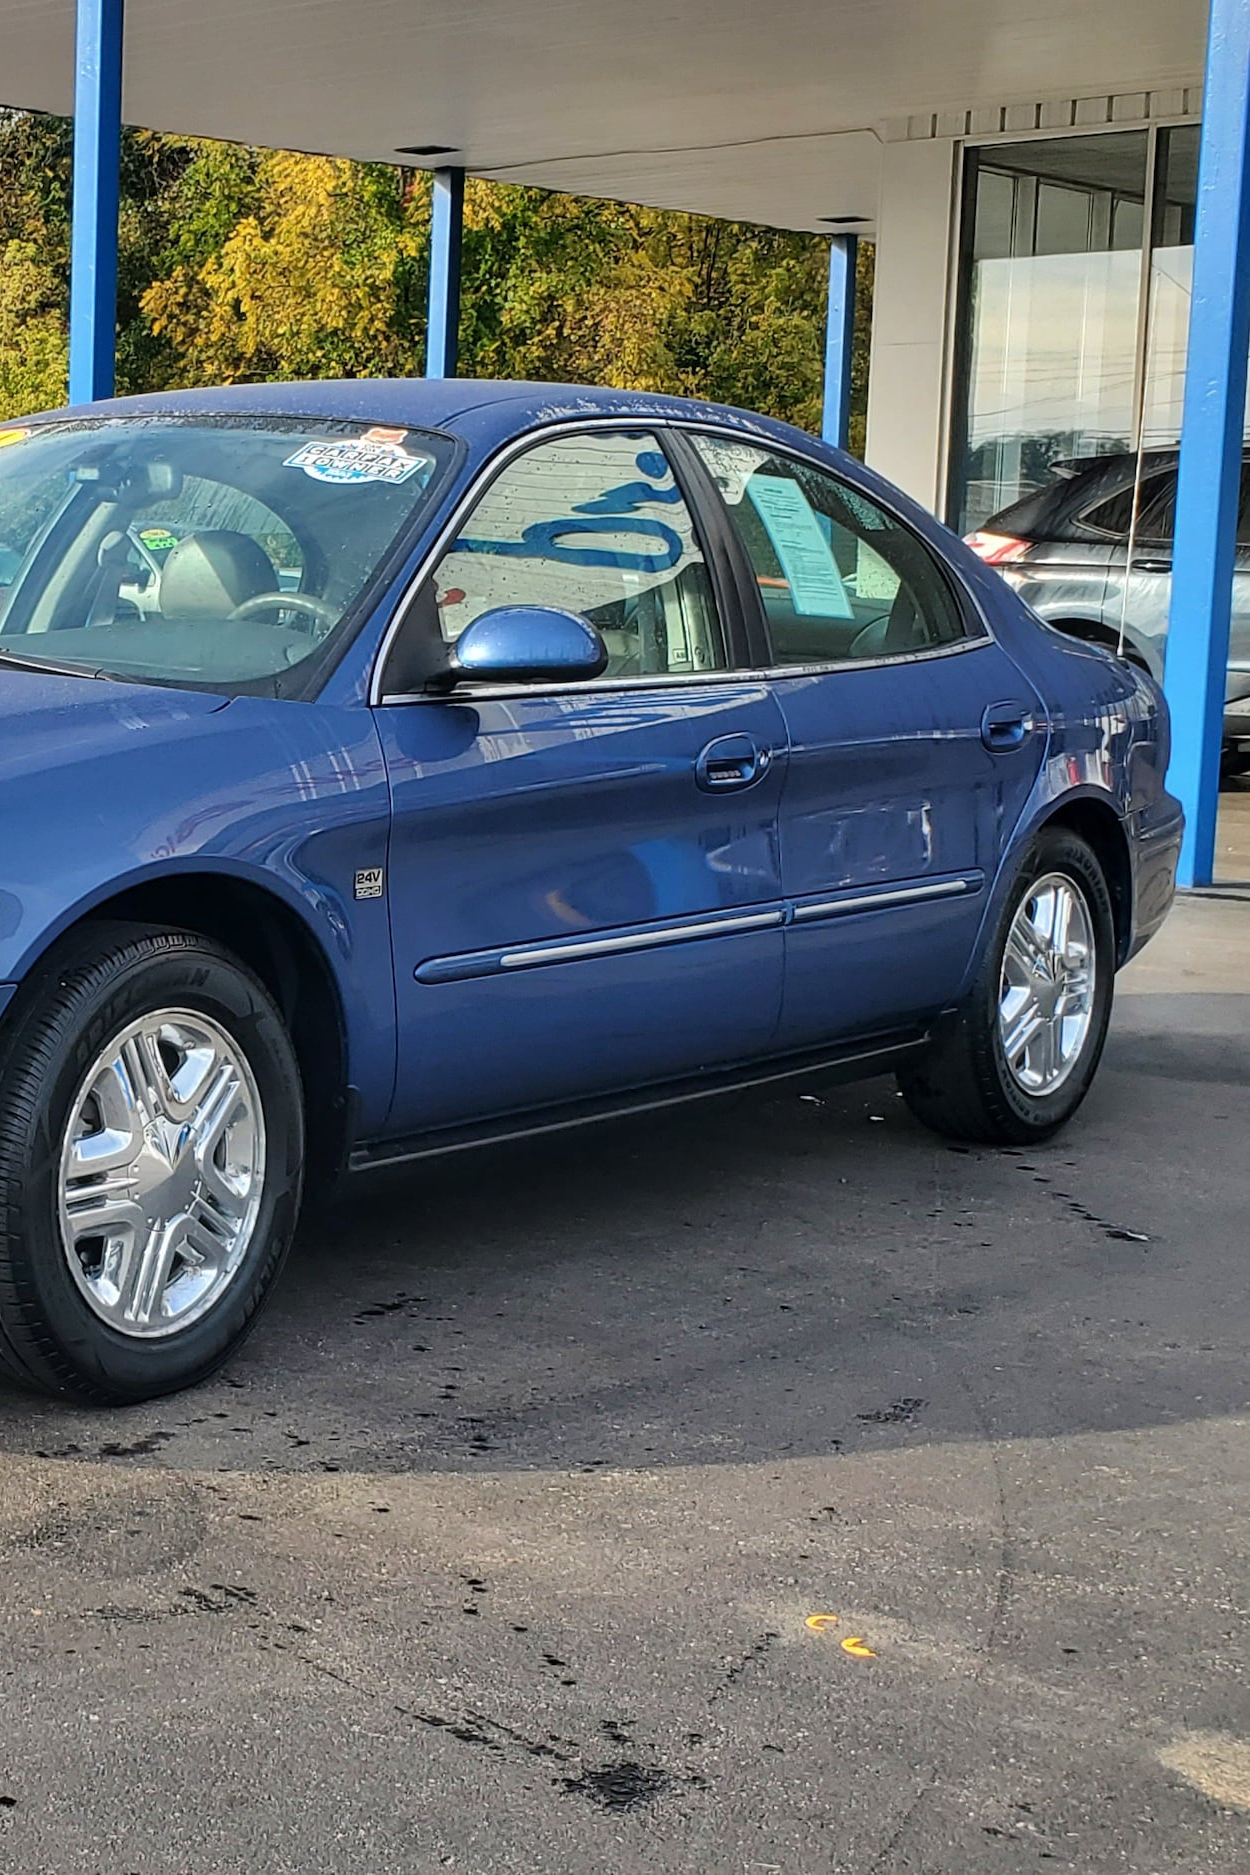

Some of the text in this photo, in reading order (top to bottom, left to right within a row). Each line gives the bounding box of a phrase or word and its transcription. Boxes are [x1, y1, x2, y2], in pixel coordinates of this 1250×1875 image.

[306, 446, 409, 470] CARFAX
[312, 457, 404, 478] OWNER
[356, 870, 381, 884] 24V
